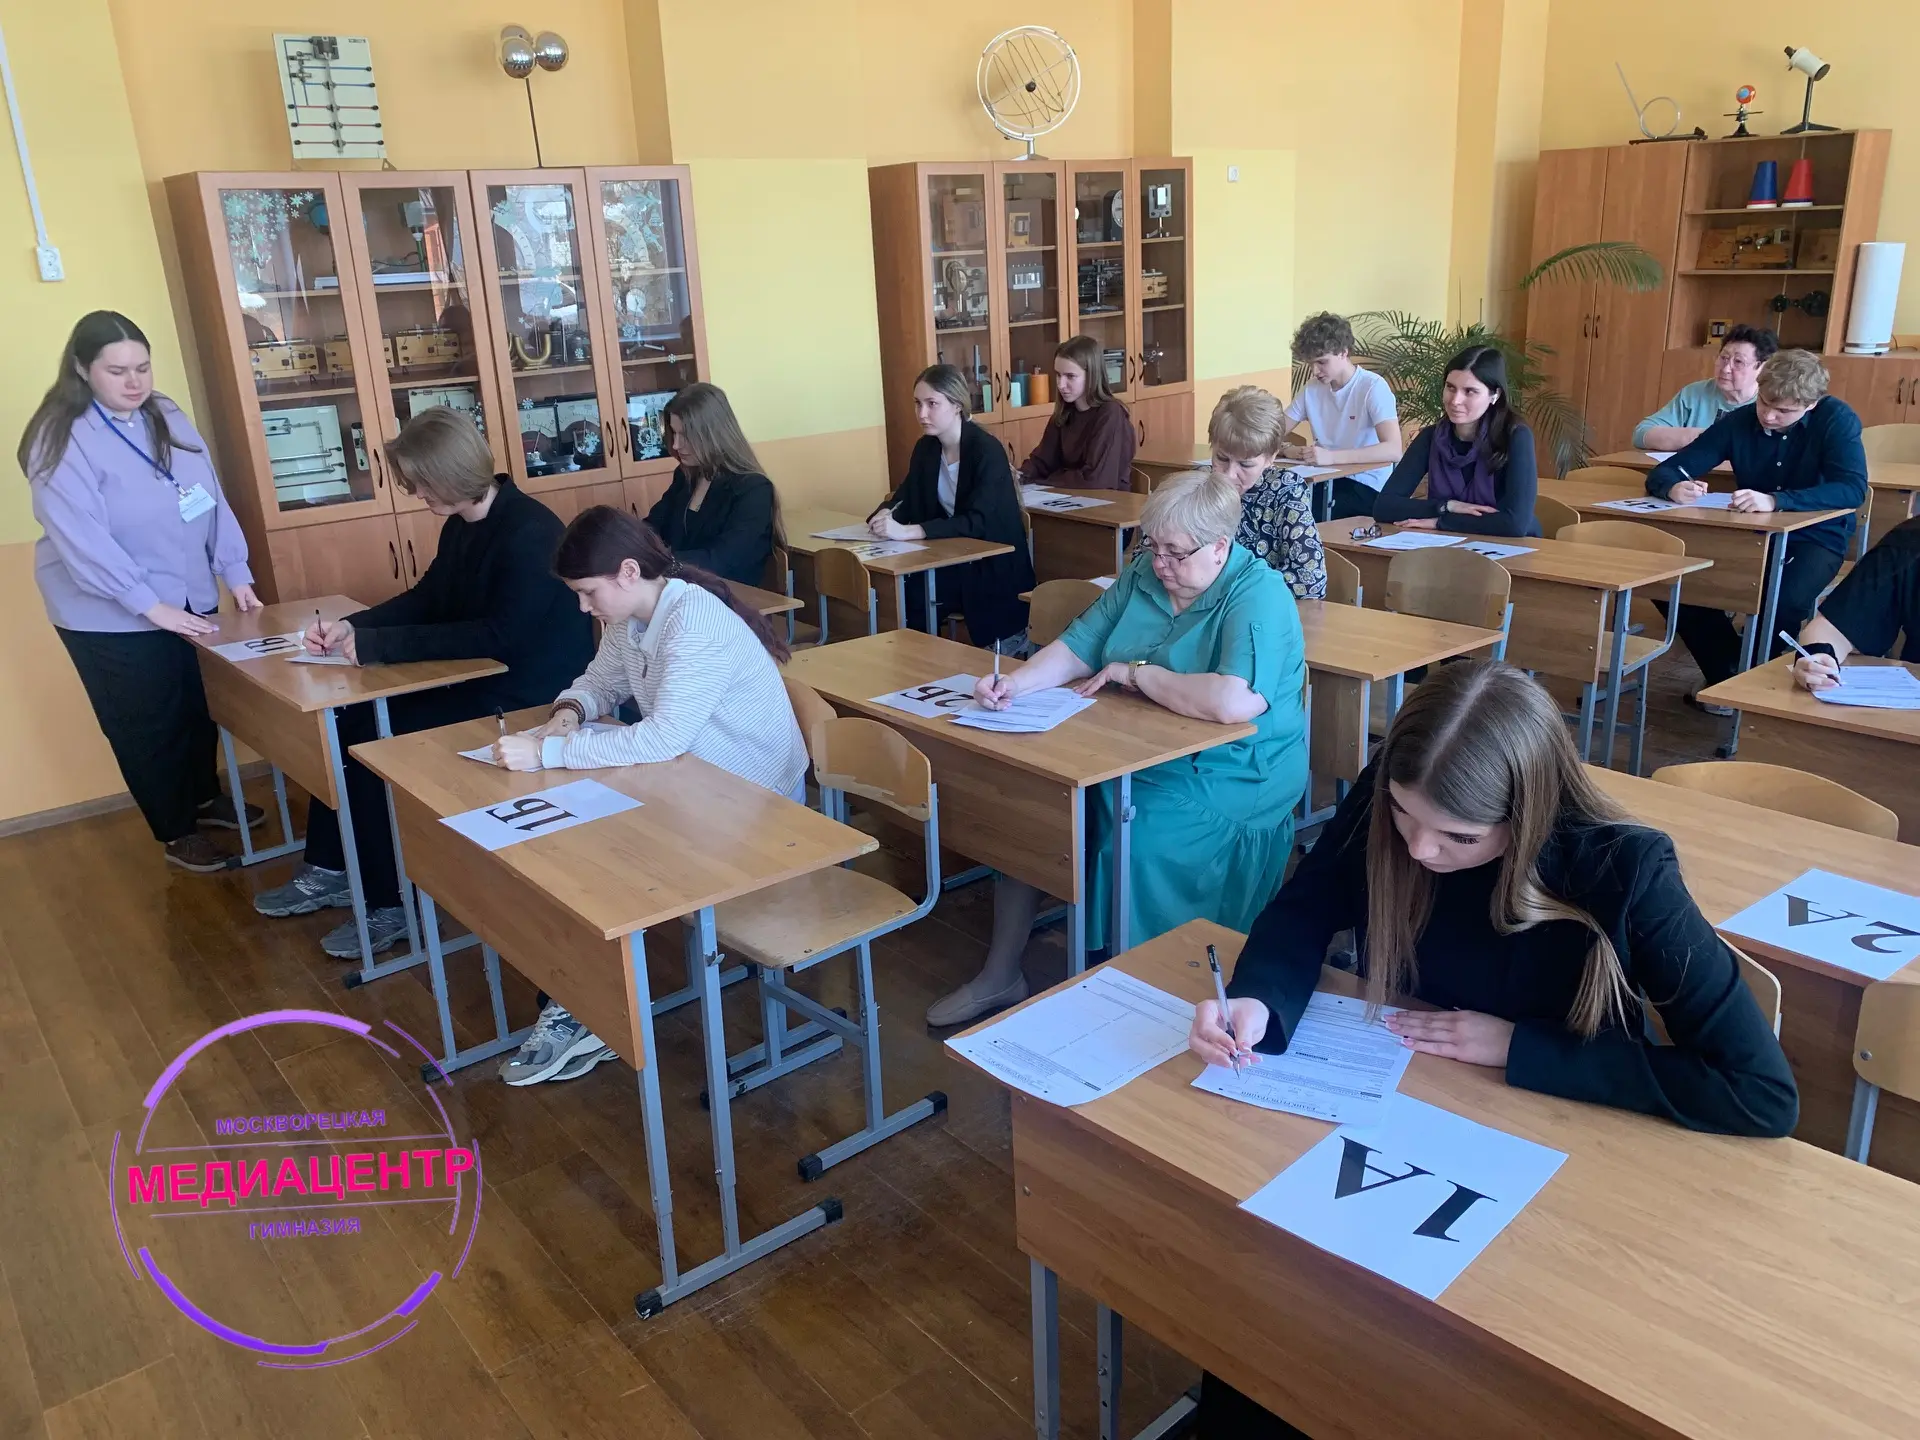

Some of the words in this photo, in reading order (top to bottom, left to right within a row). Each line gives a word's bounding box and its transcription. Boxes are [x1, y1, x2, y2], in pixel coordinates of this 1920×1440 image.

[900, 686, 974, 713] 2Б
[485, 798, 579, 831] 1Б
[1782, 893, 1920, 954] 2А
[1334, 1135, 1498, 1243] 1А
